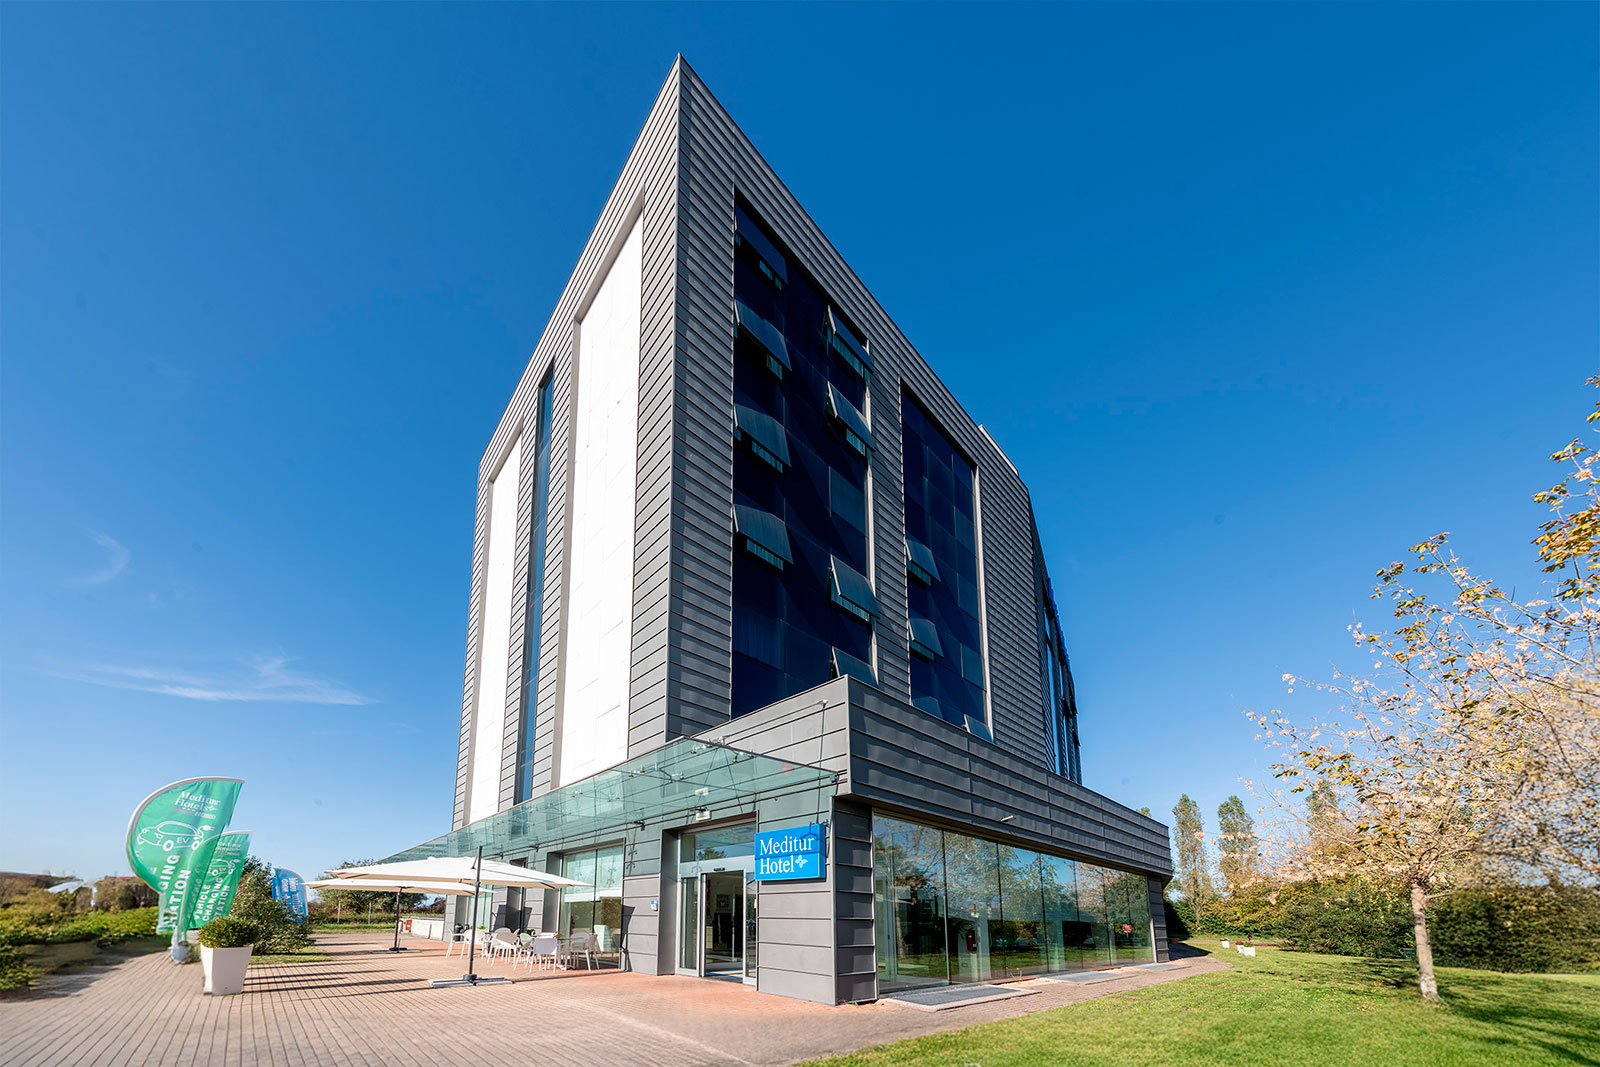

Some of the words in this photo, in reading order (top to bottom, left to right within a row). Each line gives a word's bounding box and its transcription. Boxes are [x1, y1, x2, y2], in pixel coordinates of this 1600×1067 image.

[759, 835, 815, 856] Meditur
[759, 855, 795, 875] Hotel
[193, 884, 211, 920] VEHICLE
[202, 877, 224, 922] CHARGING
